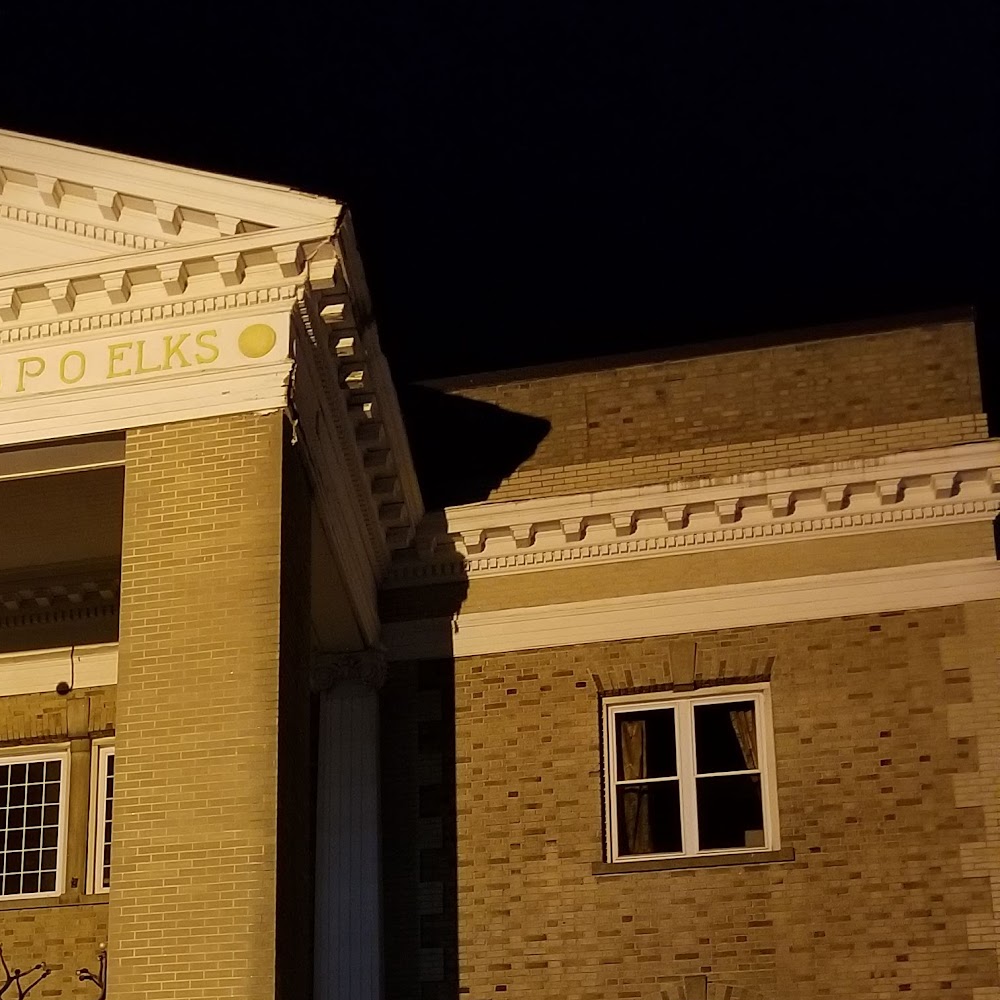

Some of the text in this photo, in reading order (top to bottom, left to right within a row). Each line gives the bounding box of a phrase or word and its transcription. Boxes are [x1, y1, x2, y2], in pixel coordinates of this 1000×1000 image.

[16, 356, 46, 392] P
[59, 350, 87, 385] O
[106, 329, 220, 379] ELKS
